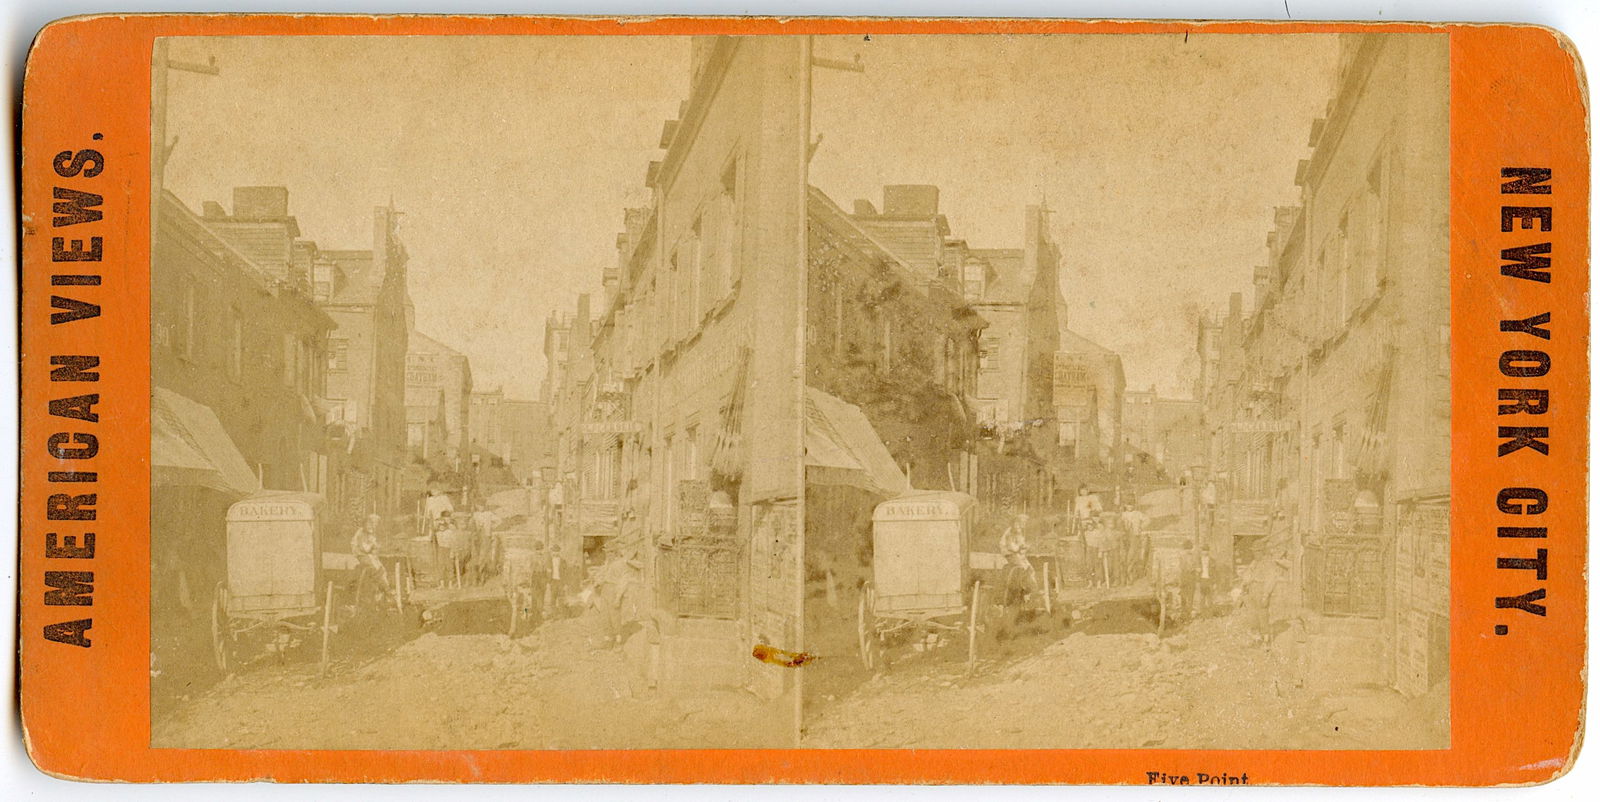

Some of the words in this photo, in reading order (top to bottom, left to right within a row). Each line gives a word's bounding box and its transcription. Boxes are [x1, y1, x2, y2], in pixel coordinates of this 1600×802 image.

[1500, 166, 1552, 283] NEW
[1497, 311, 1551, 457] YORK
[43, 355, 100, 649] AMERICAN
[1494, 487, 1548, 636] CITY.
[1146, 771, 1190, 785] Five
[1196, 772, 1248, 785] Point
